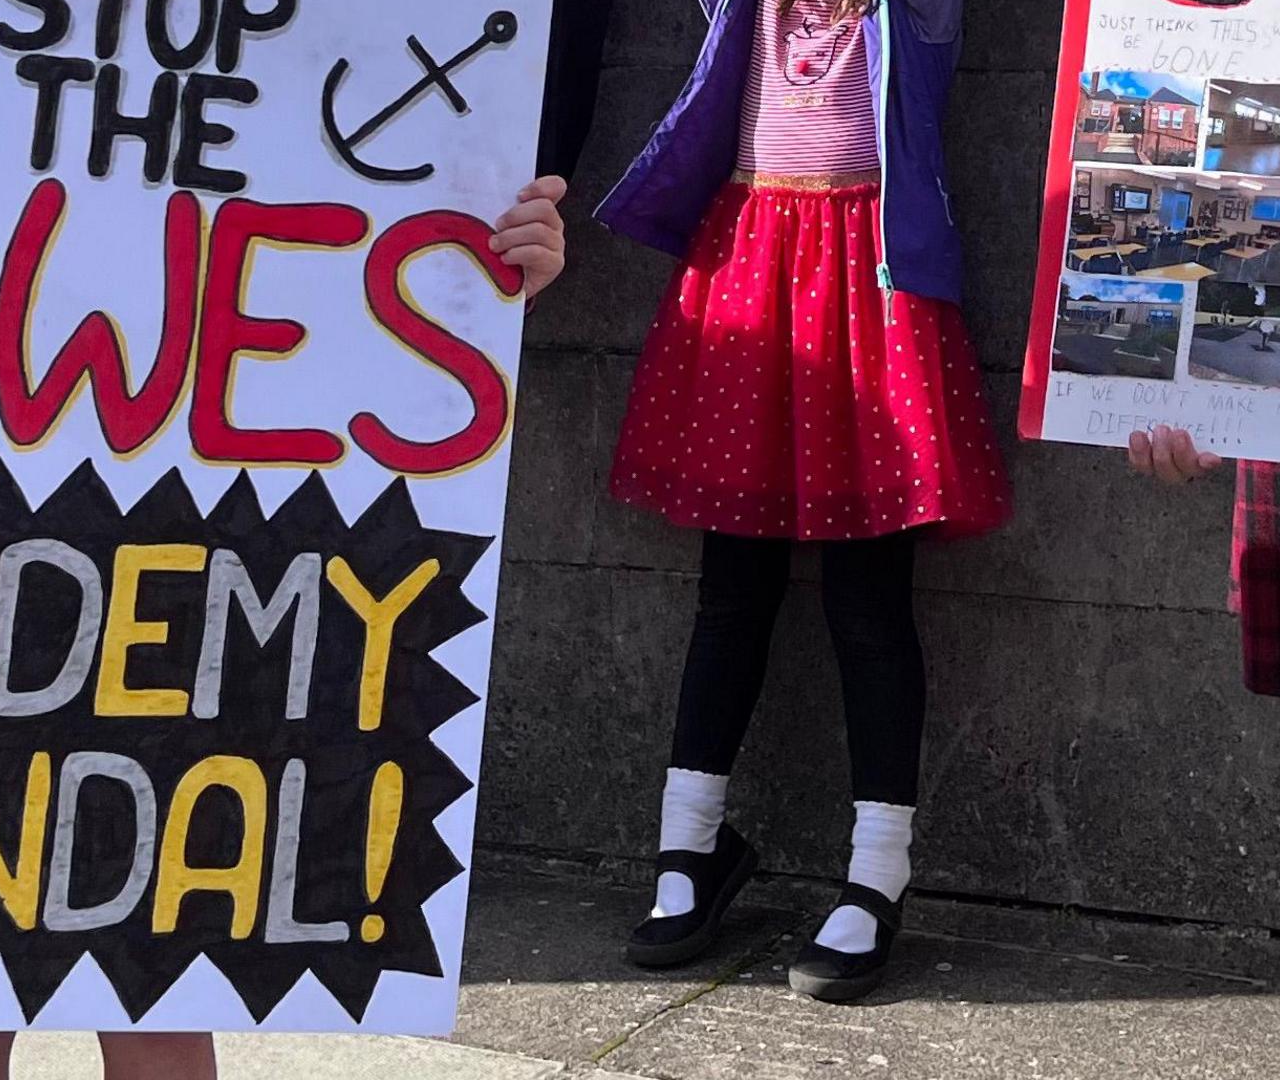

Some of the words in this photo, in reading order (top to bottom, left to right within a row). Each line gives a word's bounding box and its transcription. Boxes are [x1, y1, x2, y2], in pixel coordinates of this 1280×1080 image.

[1147, 16, 1195, 33] THINK
[1210, 19, 1258, 43] THIS
[1151, 39, 1245, 77] GONE
[17, 54, 261, 194] THE
[1090, 384, 1115, 402] WE
